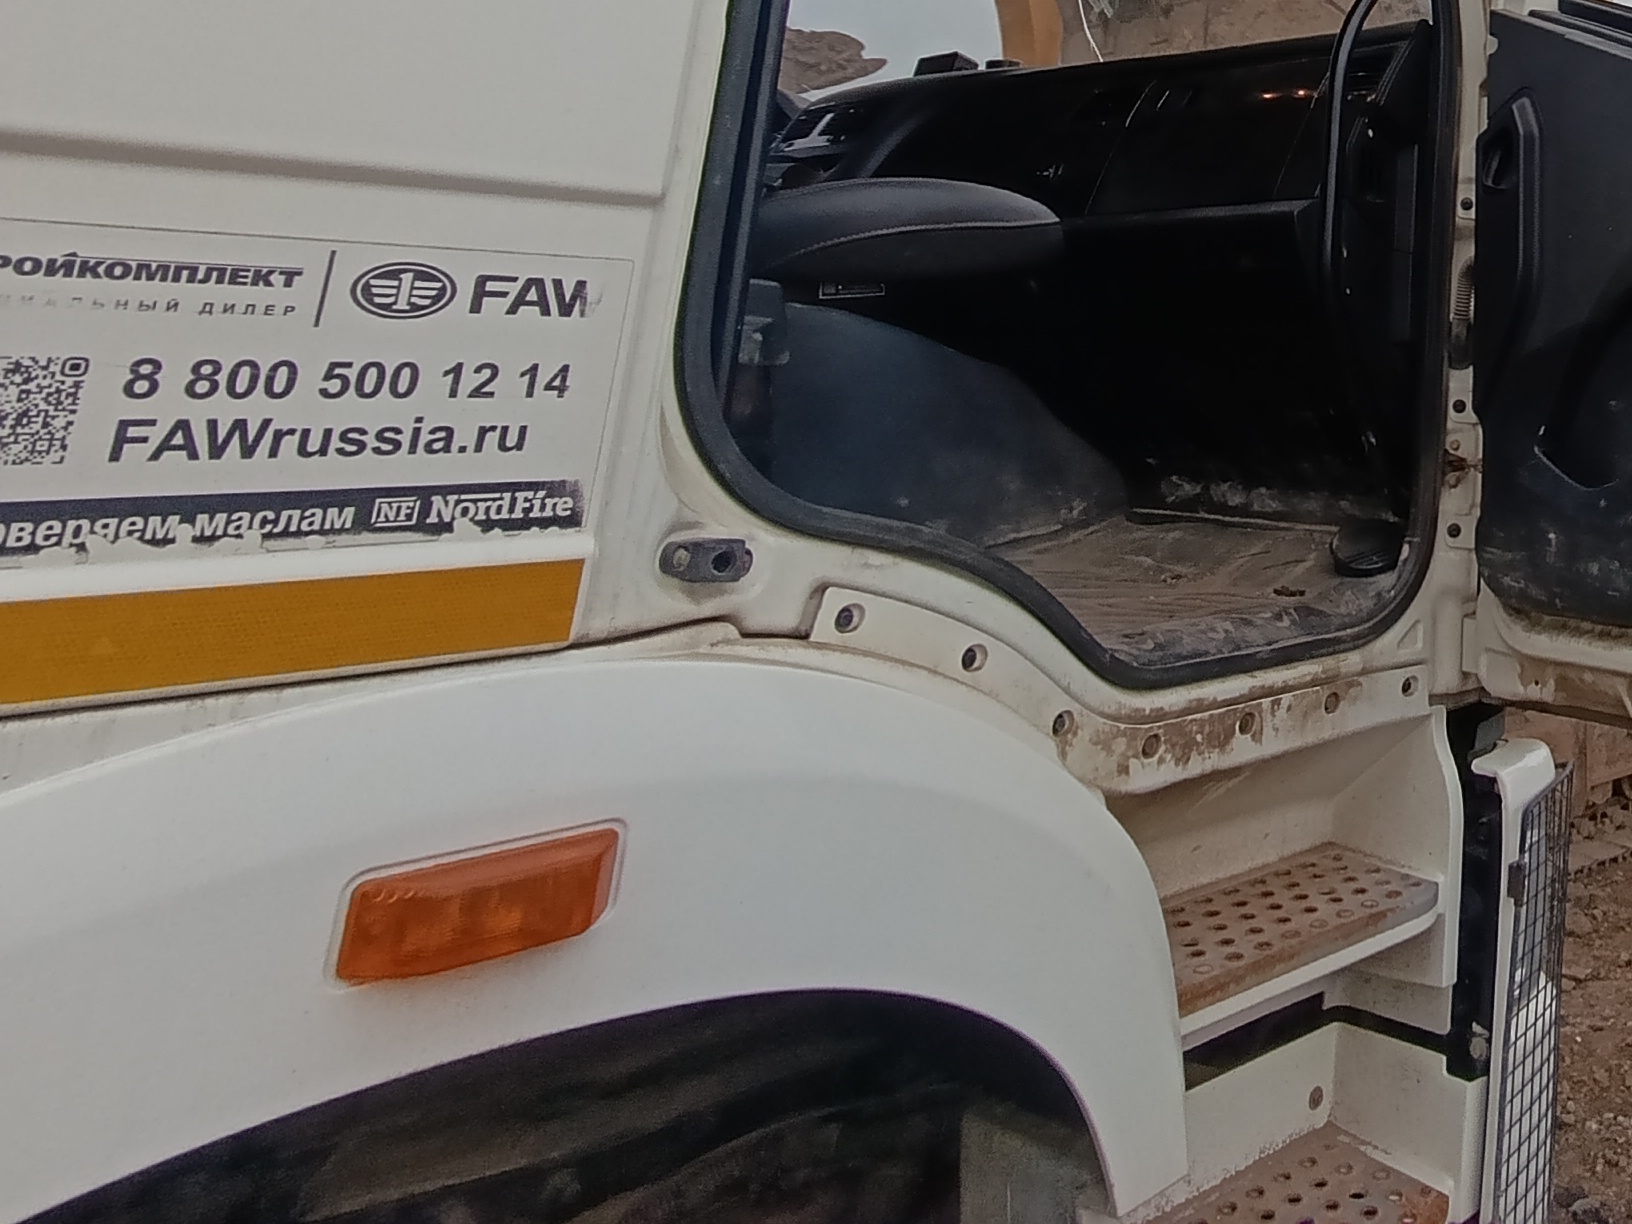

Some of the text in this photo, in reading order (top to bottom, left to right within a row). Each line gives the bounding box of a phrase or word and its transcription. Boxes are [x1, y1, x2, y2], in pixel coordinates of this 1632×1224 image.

[0, 293, 297, 317] ЛЬНЫЙ ДИЛЕР
[122, 357, 571, 400] 8 800 500 12 14
[107, 416, 528, 463] FAWrussia.ru
[0, 506, 355, 549] веряем маслам
[377, 490, 575, 525] NF NordFire
